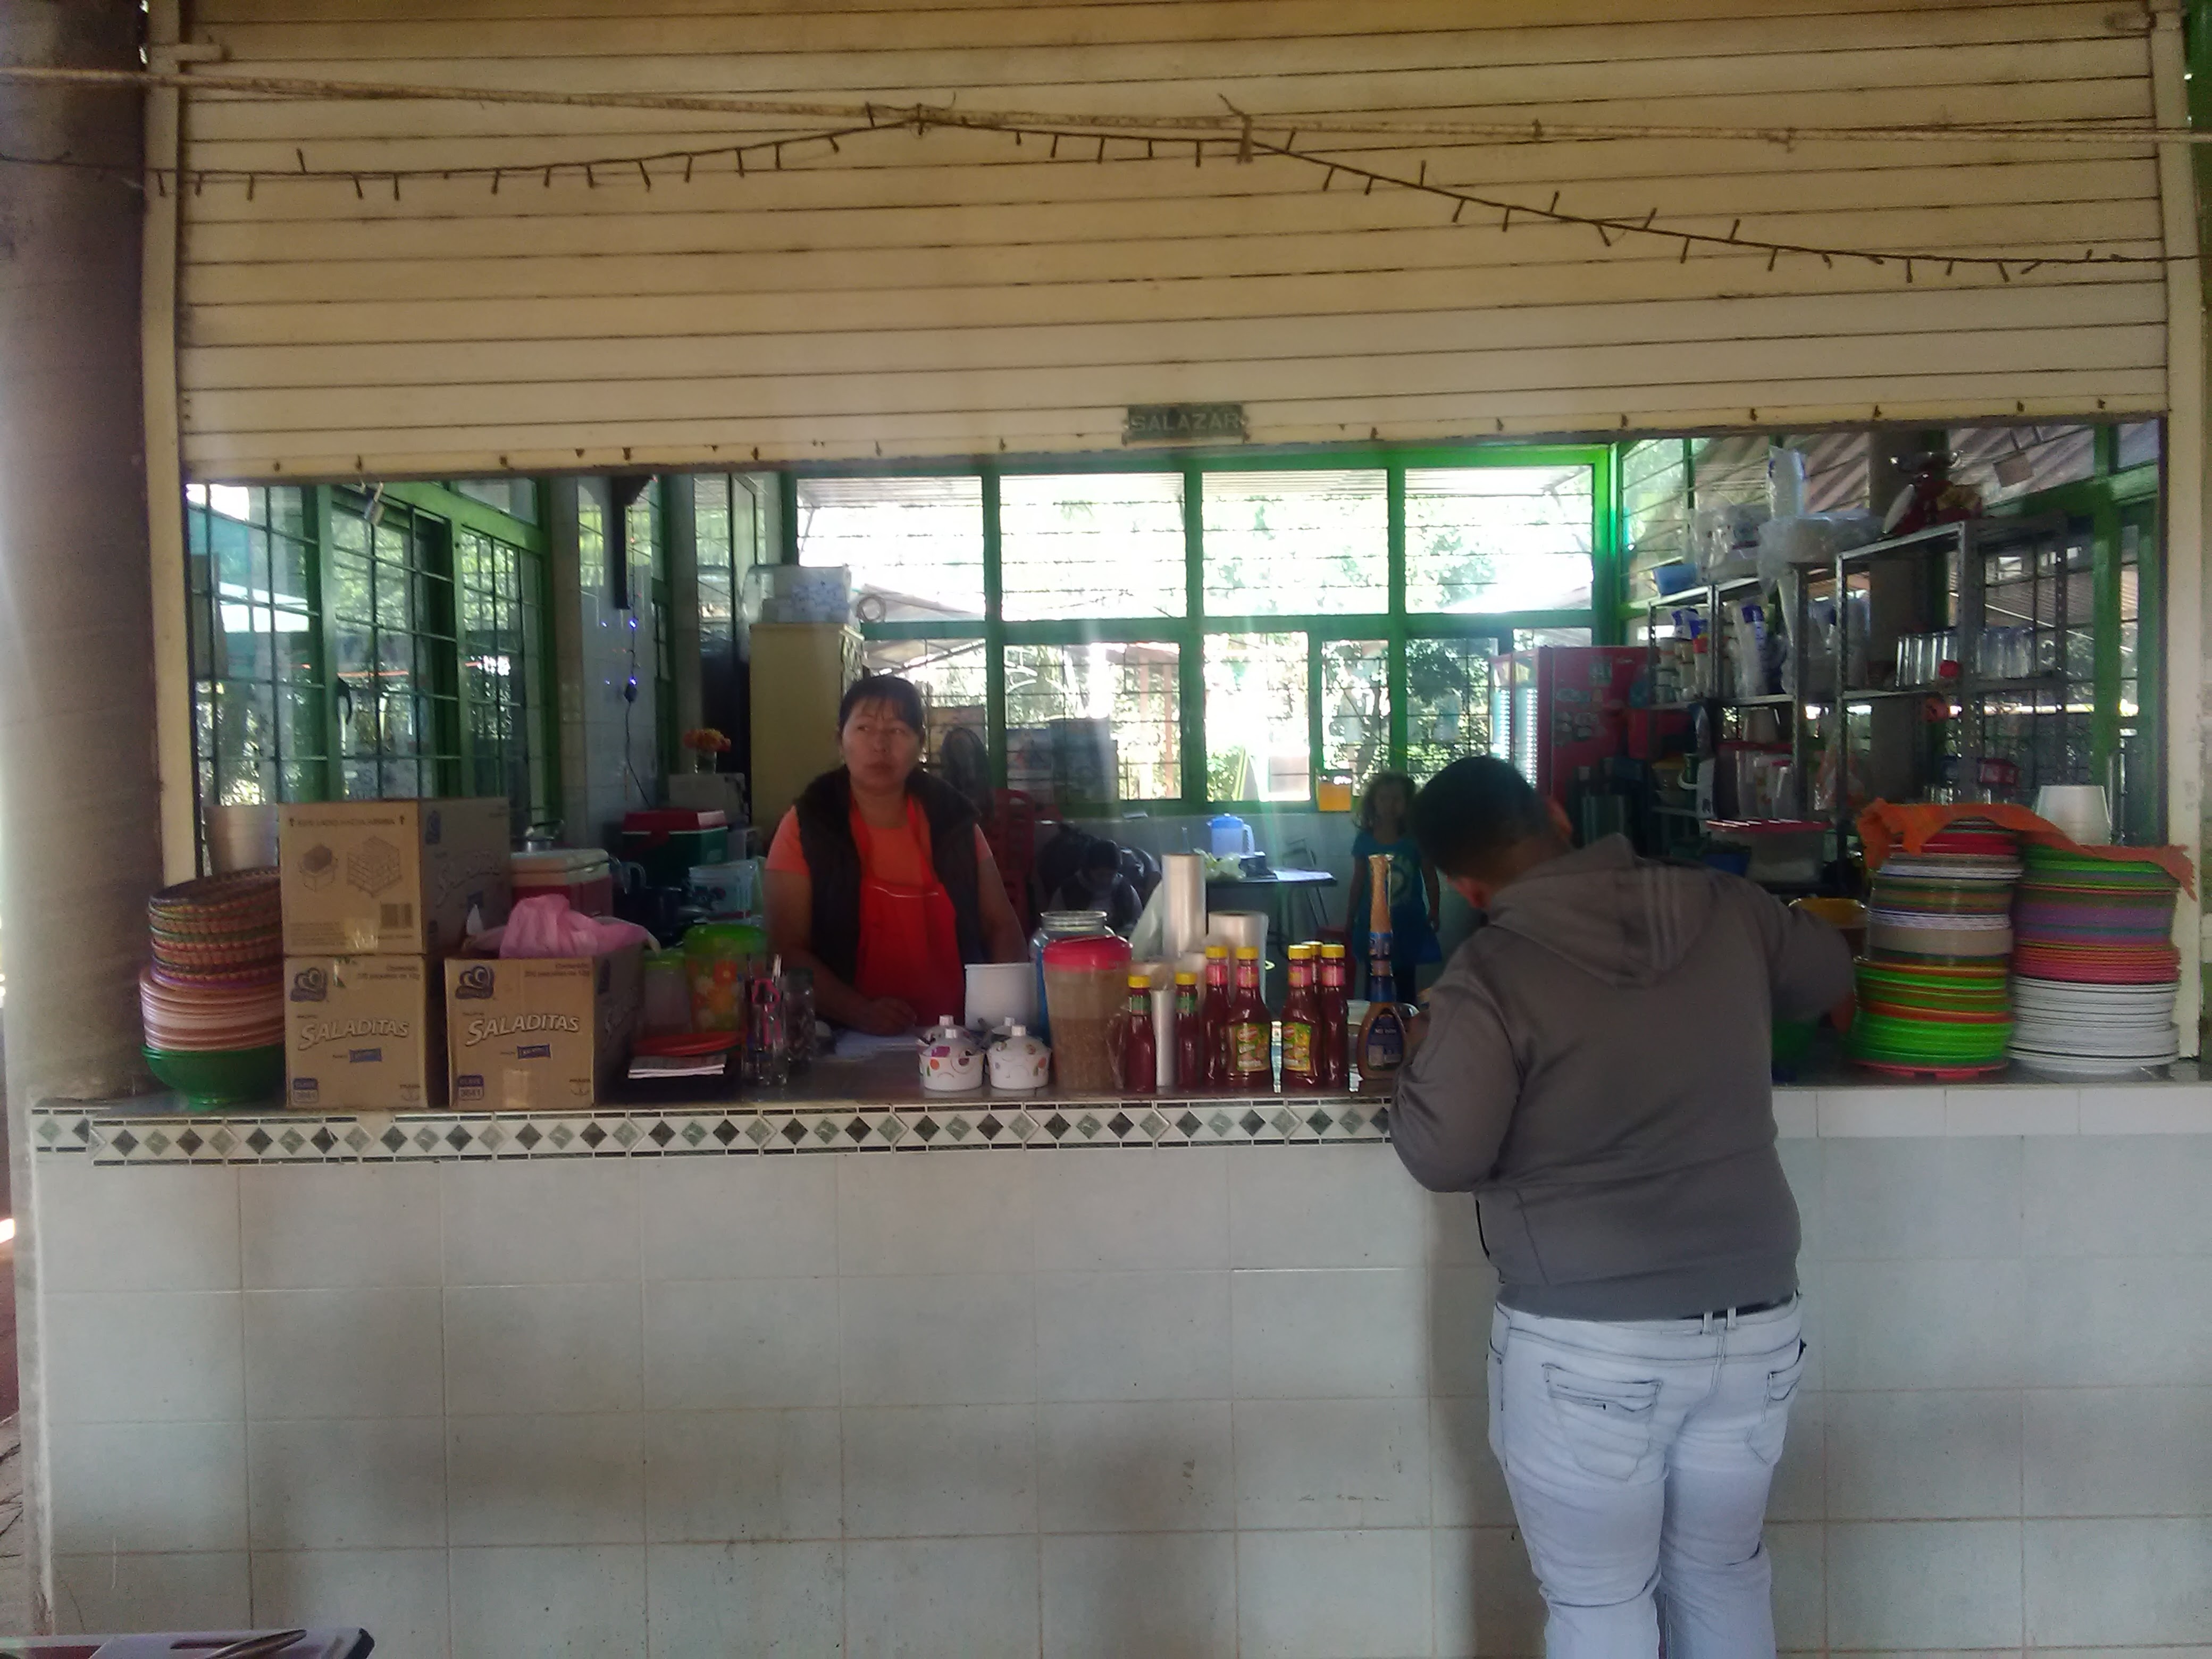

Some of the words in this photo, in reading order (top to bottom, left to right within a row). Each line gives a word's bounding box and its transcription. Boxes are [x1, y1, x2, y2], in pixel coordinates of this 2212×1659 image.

[1130, 412, 1239, 431] SALAZAR
[298, 1018, 409, 1051] SALADITAS
[465, 1013, 580, 1046] SALADITAS
